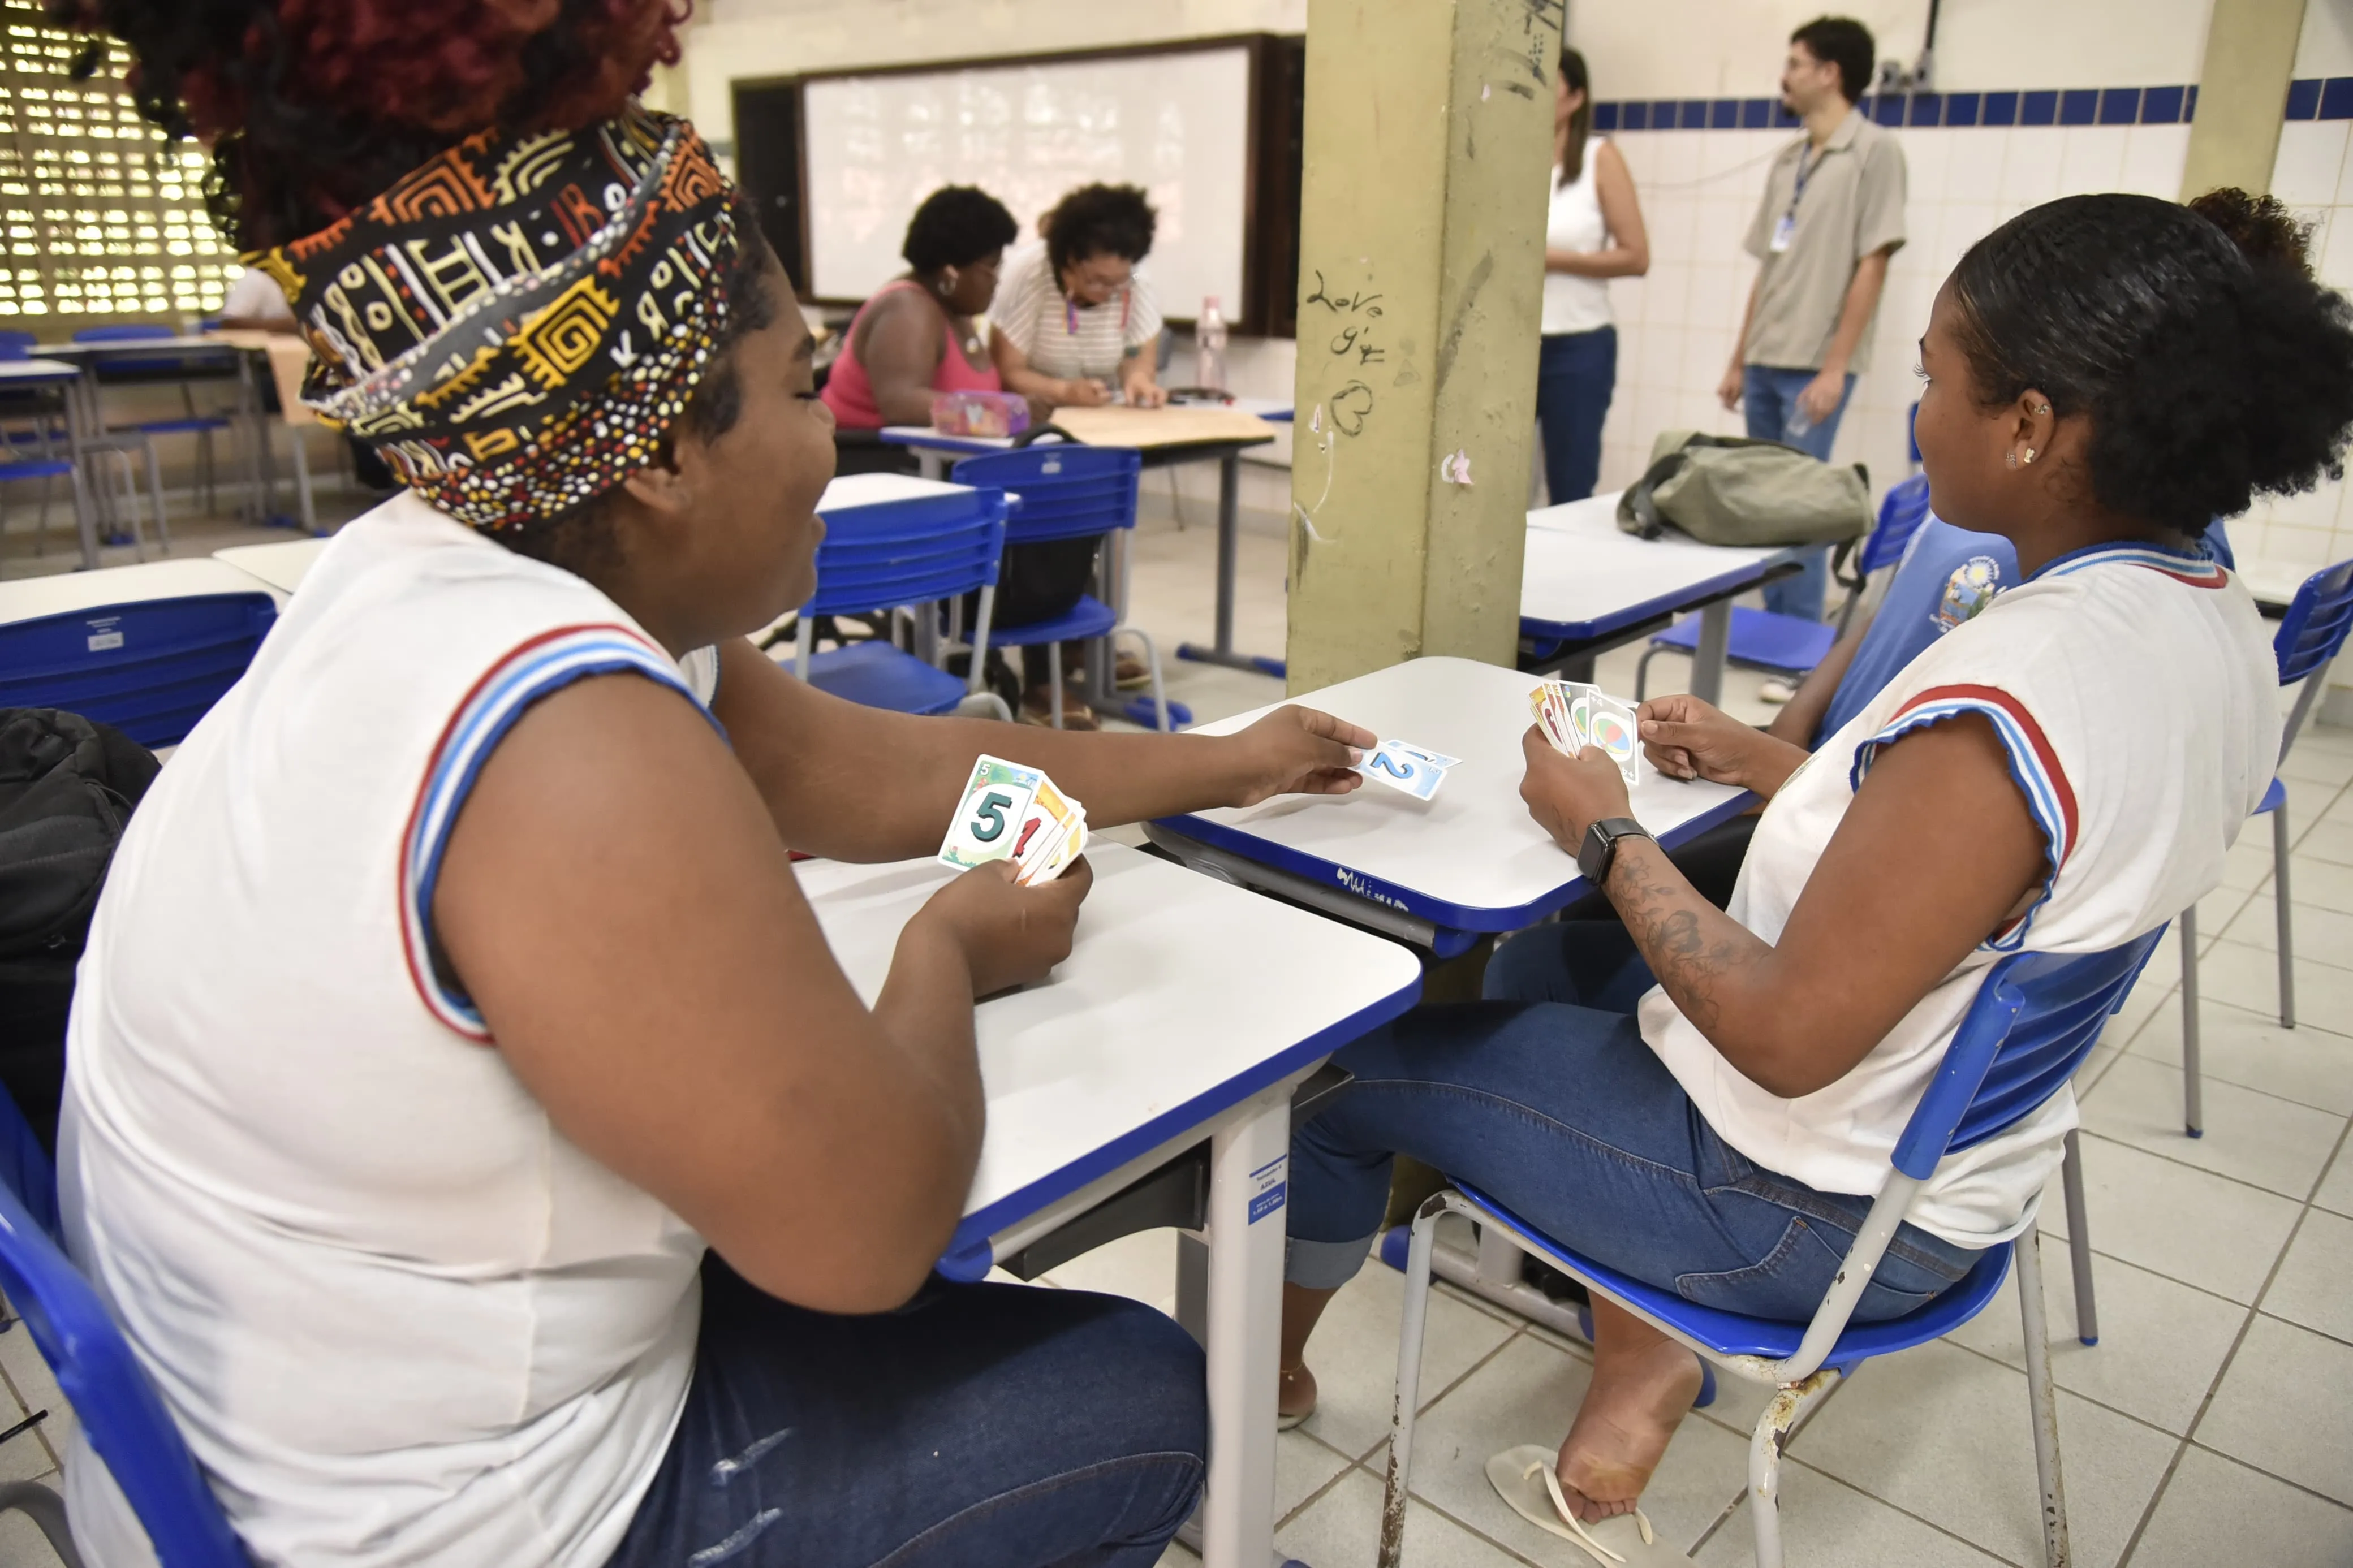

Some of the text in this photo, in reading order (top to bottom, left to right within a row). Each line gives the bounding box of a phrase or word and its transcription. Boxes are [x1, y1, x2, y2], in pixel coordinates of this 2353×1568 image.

[1591, 696, 1602, 706] +4
[980, 764, 991, 775] 5
[1370, 751, 1414, 779] 2
[971, 792, 1012, 843] 5
[1012, 817, 1041, 858] 1
